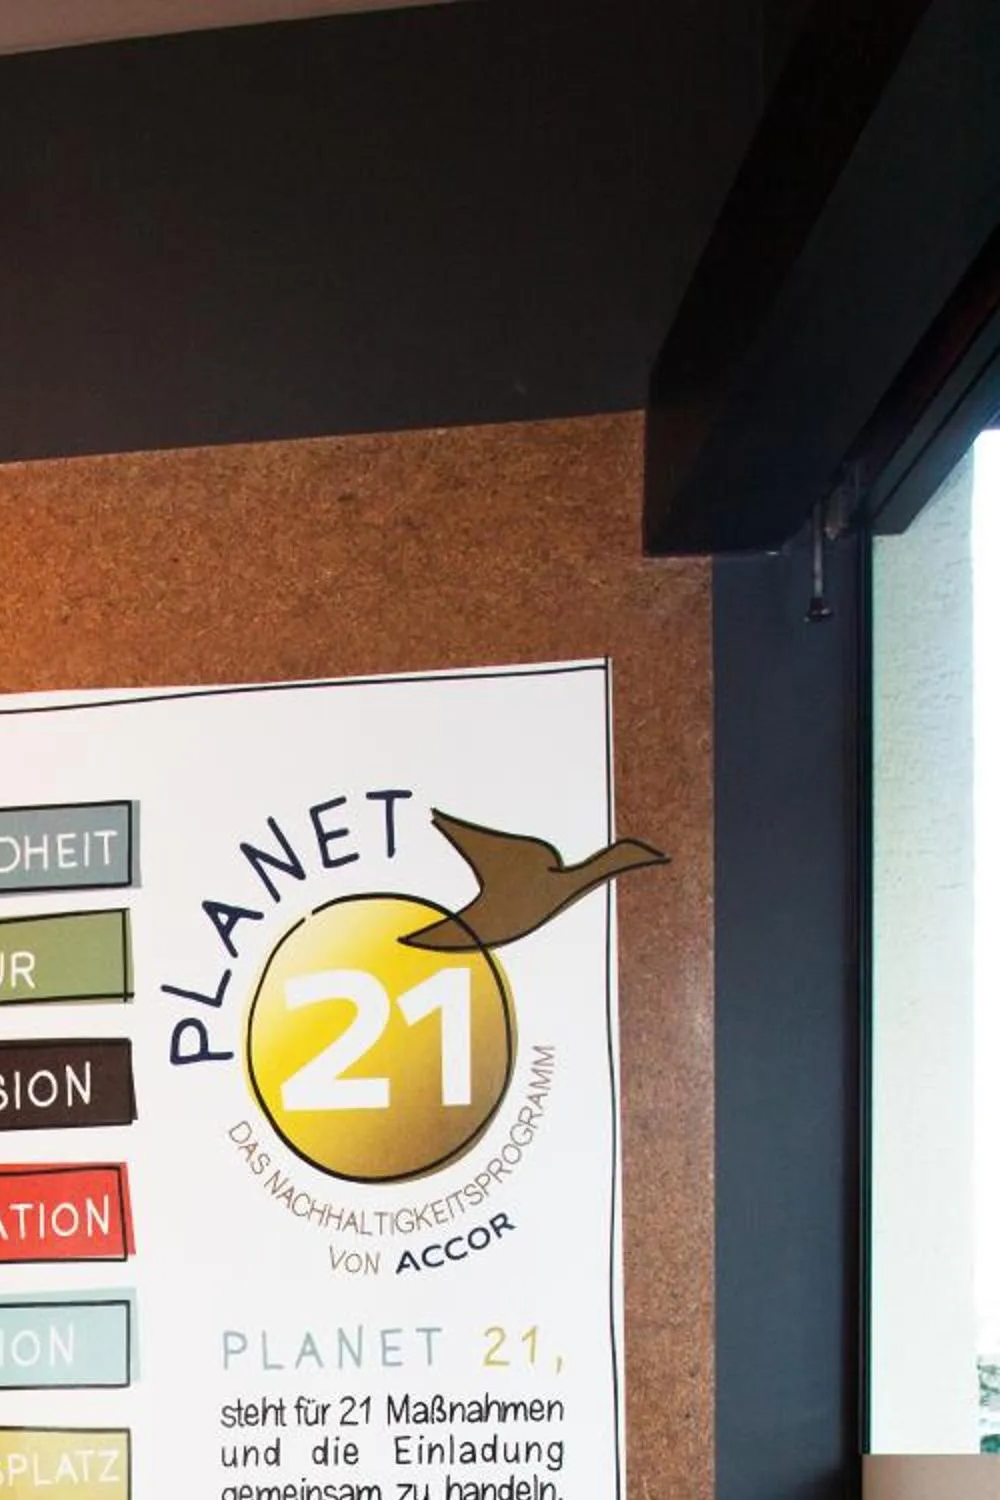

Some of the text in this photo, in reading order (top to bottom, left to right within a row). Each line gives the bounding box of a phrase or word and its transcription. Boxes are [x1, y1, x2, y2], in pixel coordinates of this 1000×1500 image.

[161, 789, 413, 1065] PLANET
[280, 966, 472, 1112] 21
[227, 1043, 556, 1236] DAS NACHHALTIGKEITSPROGRAMM
[328, 1211, 516, 1274] VON ACCOR
[222, 1325, 564, 1375] PLANET 21,
[220, 1392, 564, 1428] steht für 21 Maßnahmen
[221, 1434, 564, 1471] und die Einladung
